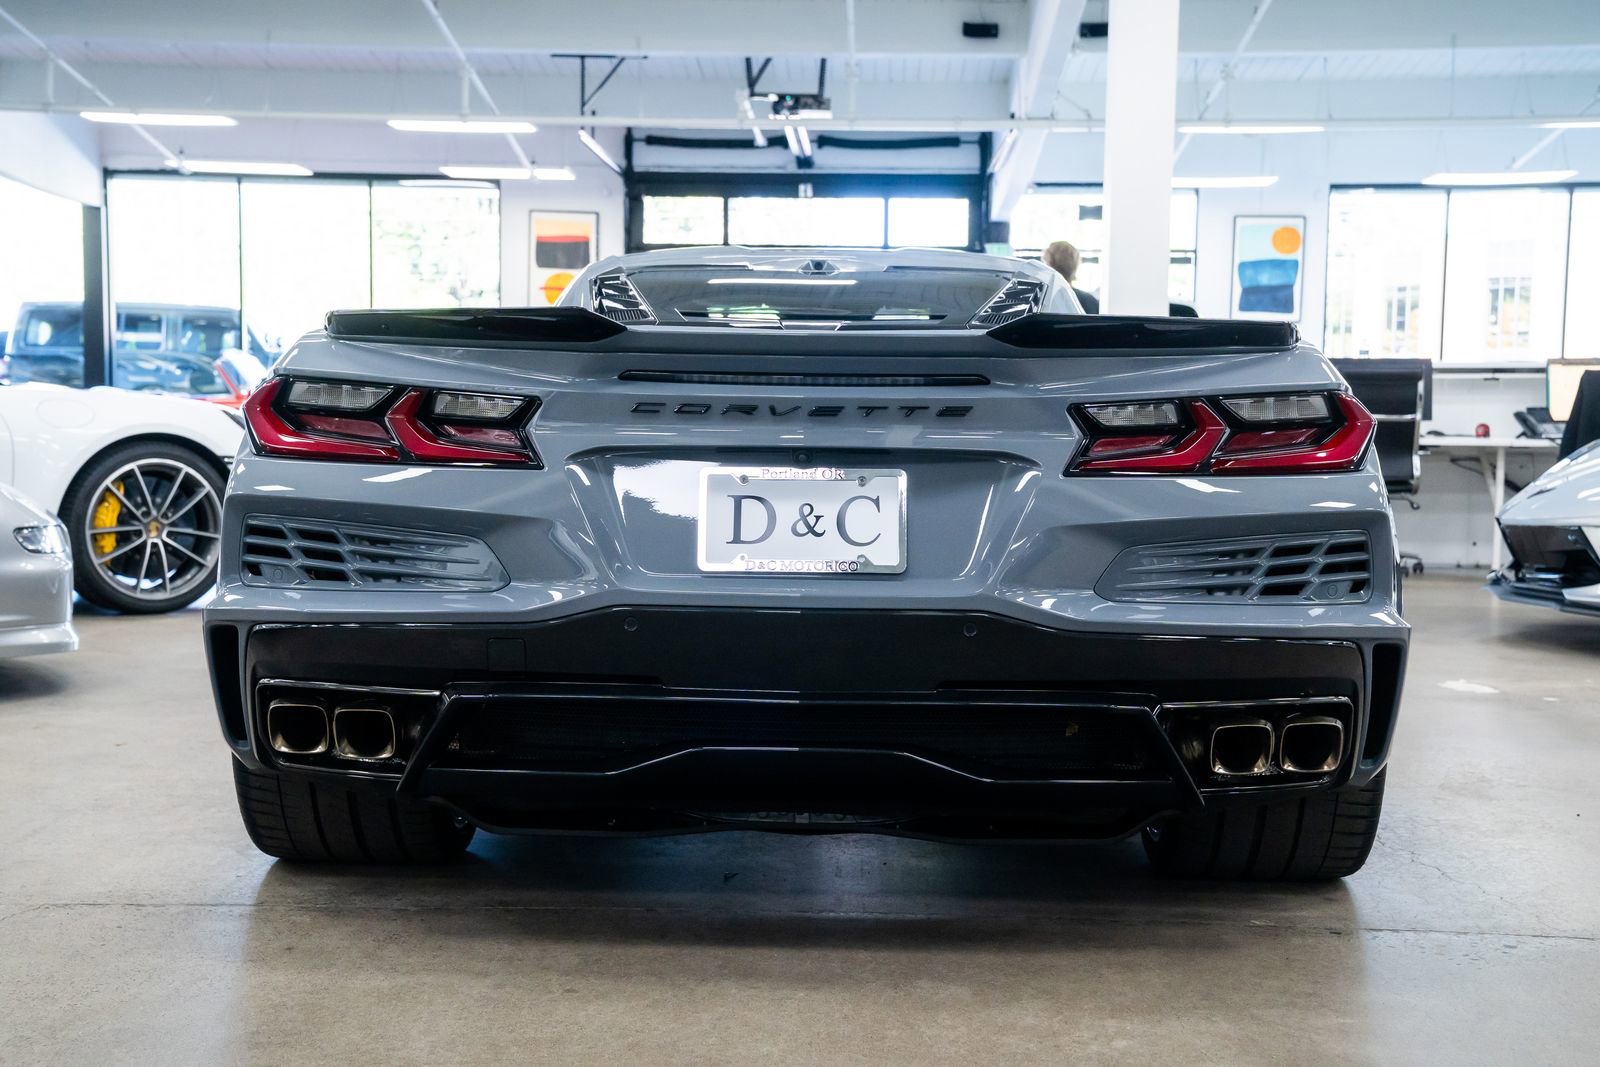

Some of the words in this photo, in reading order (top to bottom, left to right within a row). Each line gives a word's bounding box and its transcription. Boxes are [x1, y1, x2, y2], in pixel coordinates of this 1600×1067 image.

[629, 402, 975, 418] CORVETTE
[761, 468, 818, 480] Portland
[821, 468, 846, 480] OR
[725, 494, 777, 545] D
[790, 502, 827, 538] &
[836, 495, 882, 547] C
[744, 560, 777, 572] D&C
